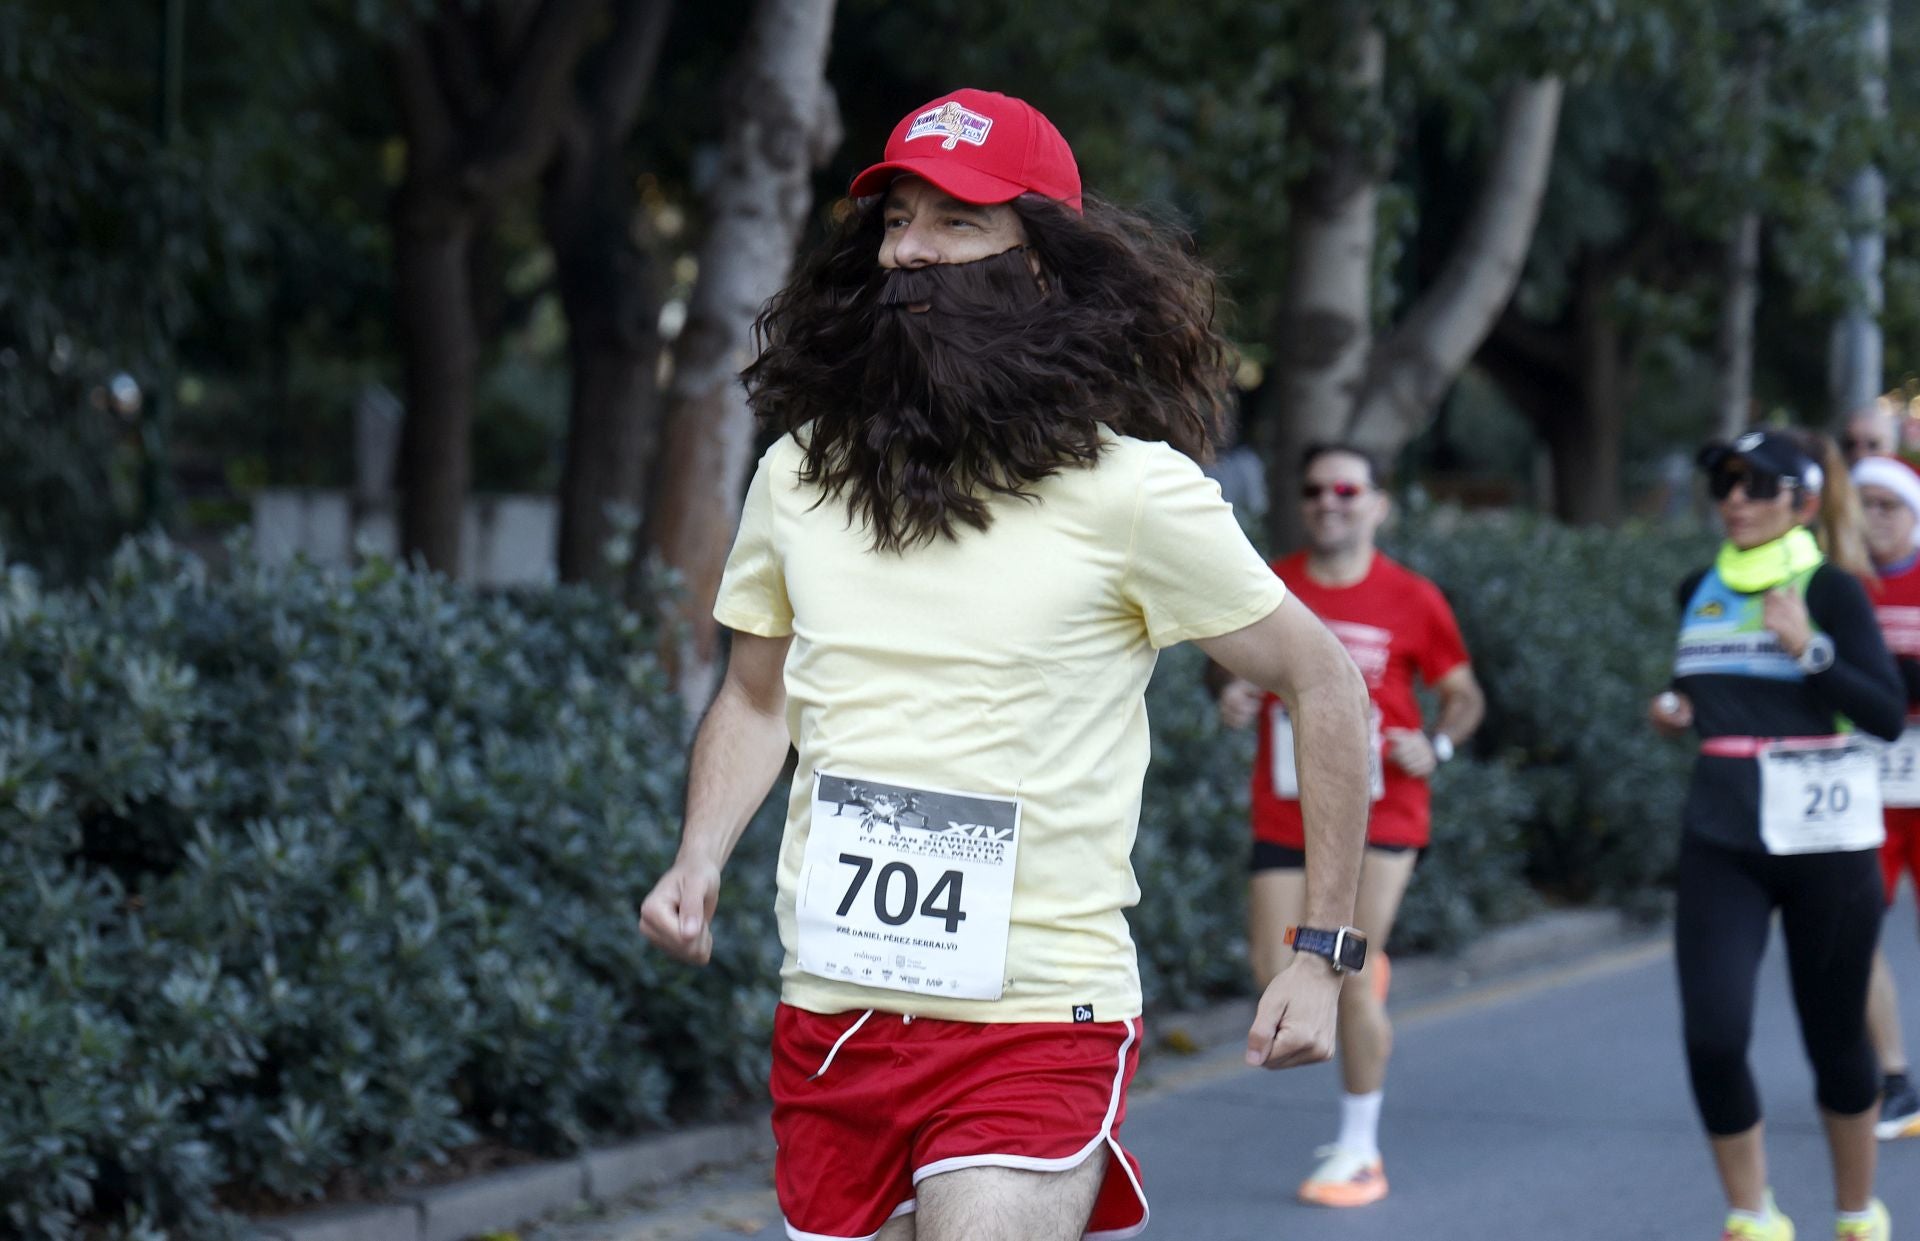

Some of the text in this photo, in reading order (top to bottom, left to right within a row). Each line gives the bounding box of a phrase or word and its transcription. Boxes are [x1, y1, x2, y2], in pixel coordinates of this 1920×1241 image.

[1804, 783, 1849, 816] 20
[929, 833, 1004, 849] CARRERA
[941, 820, 1013, 840] XIV
[859, 835, 909, 849] PALMA
[919, 845, 1004, 862] PALMILLA
[890, 834, 1004, 855] SAN SILVESTRE
[836, 853, 966, 933] 704
[852, 928, 881, 941] DANIEL
[912, 938, 958, 951] SERRALVO
